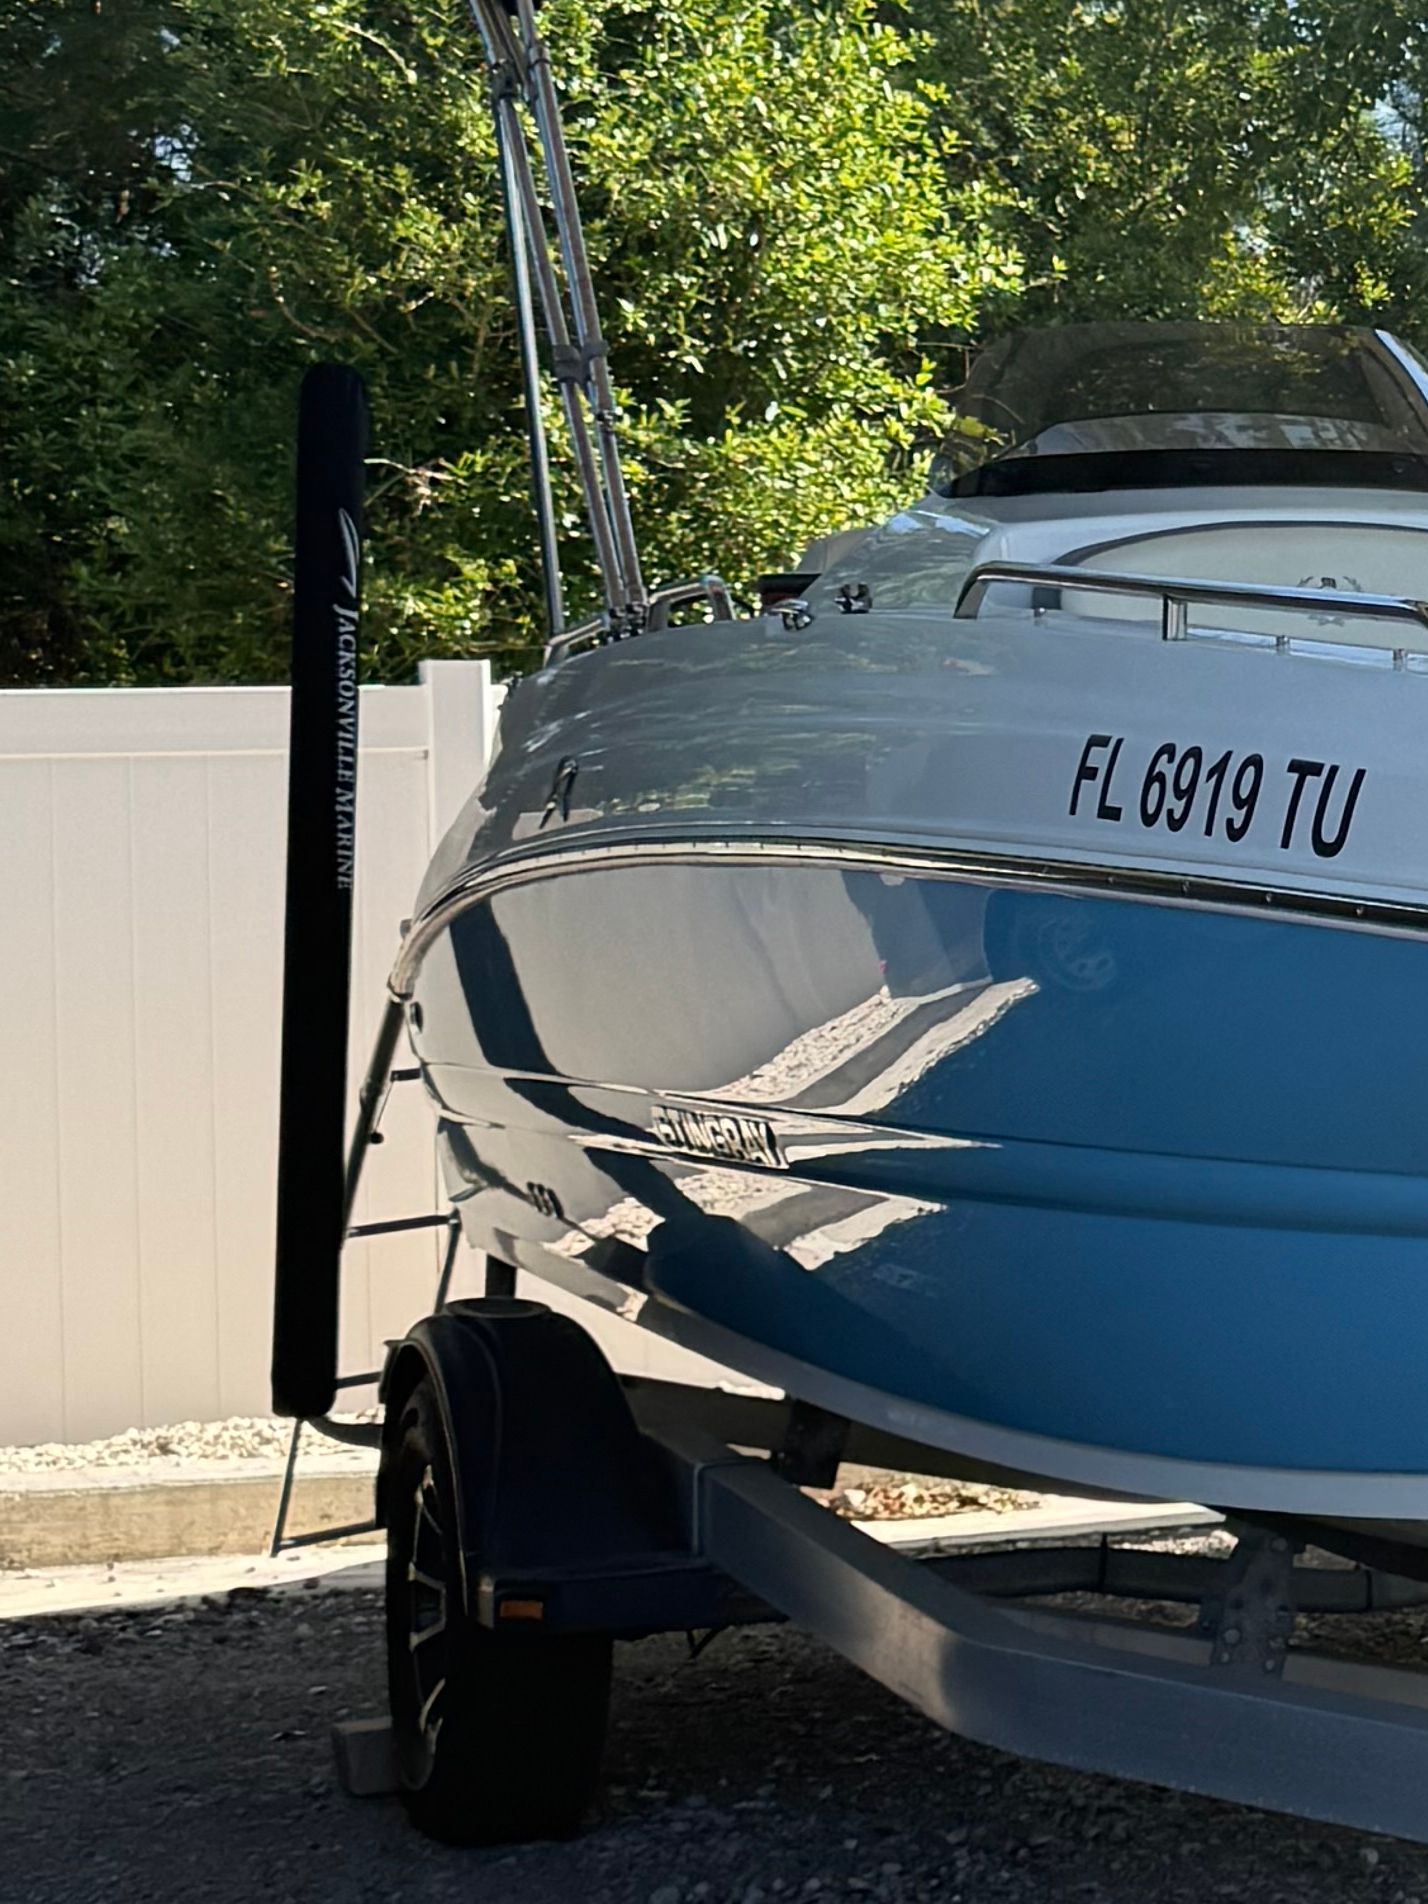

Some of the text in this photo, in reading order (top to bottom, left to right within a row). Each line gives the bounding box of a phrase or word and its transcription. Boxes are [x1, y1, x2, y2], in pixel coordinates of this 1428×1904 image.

[332, 603, 359, 891] JACKSONVILLE MARINE
[1069, 733, 1367, 859] FL 6919 TU
[651, 1104, 788, 1169] STINGRAY
